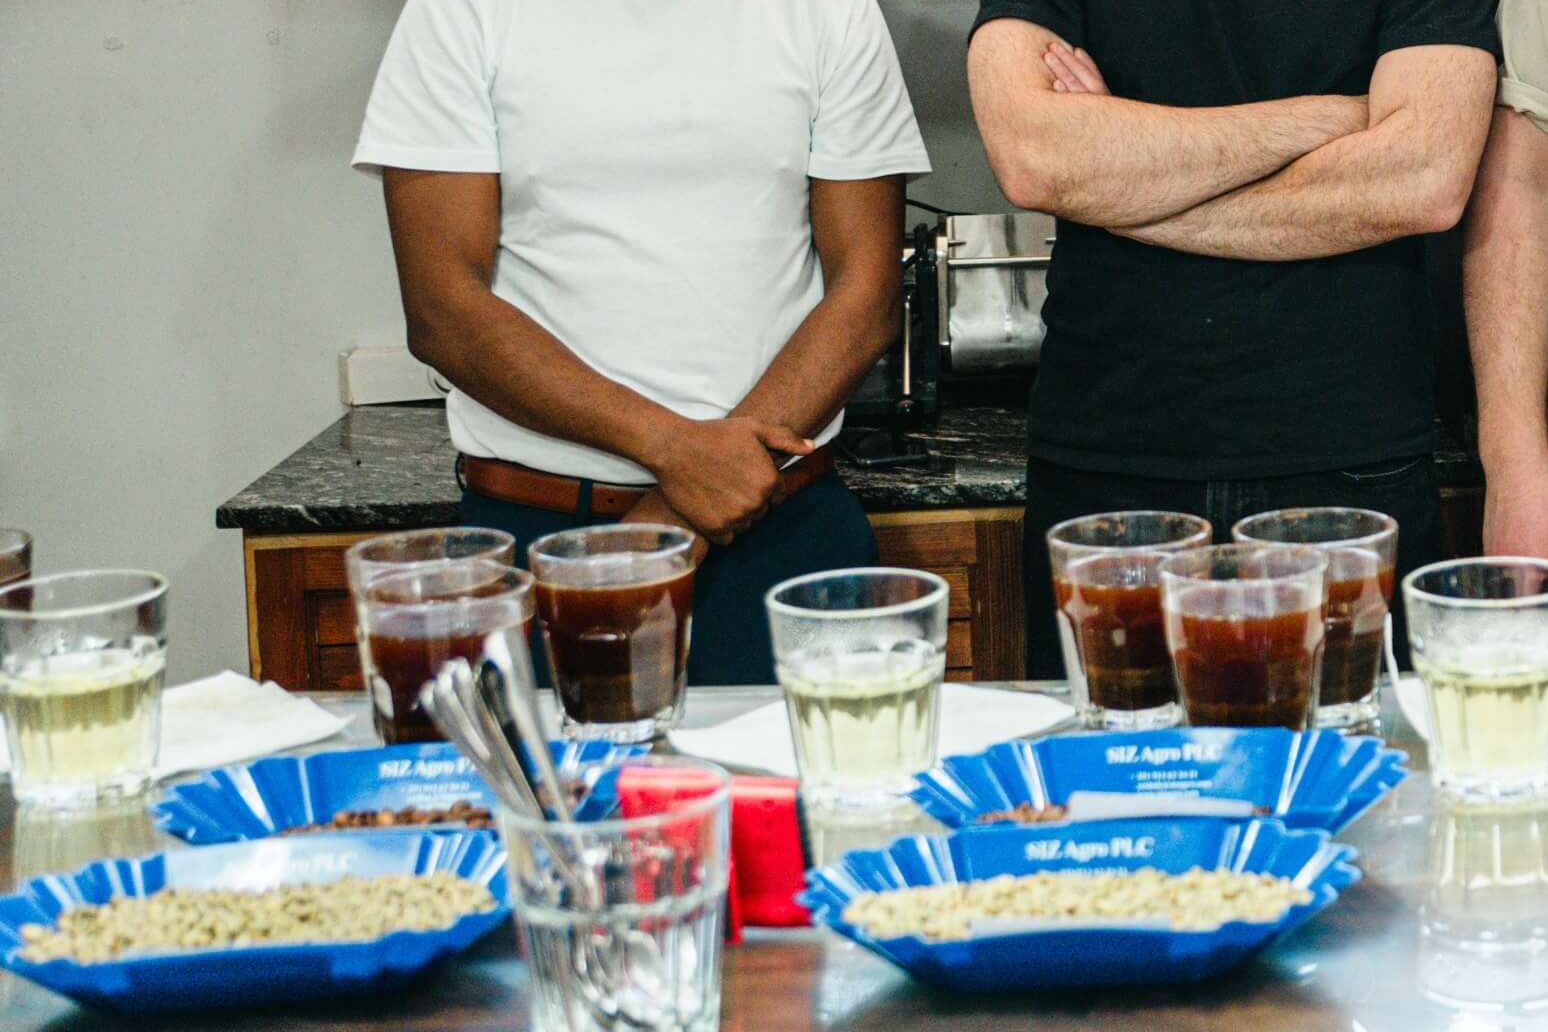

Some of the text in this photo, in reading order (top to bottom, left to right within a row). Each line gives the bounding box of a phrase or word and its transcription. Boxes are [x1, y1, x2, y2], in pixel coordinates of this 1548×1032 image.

[1105, 742, 1224, 766] SIZ Agro PLC
[378, 759, 413, 778] SIZ
[414, 759, 456, 779] Agro
[1024, 836, 1155, 863] SIZ Agro PLC
